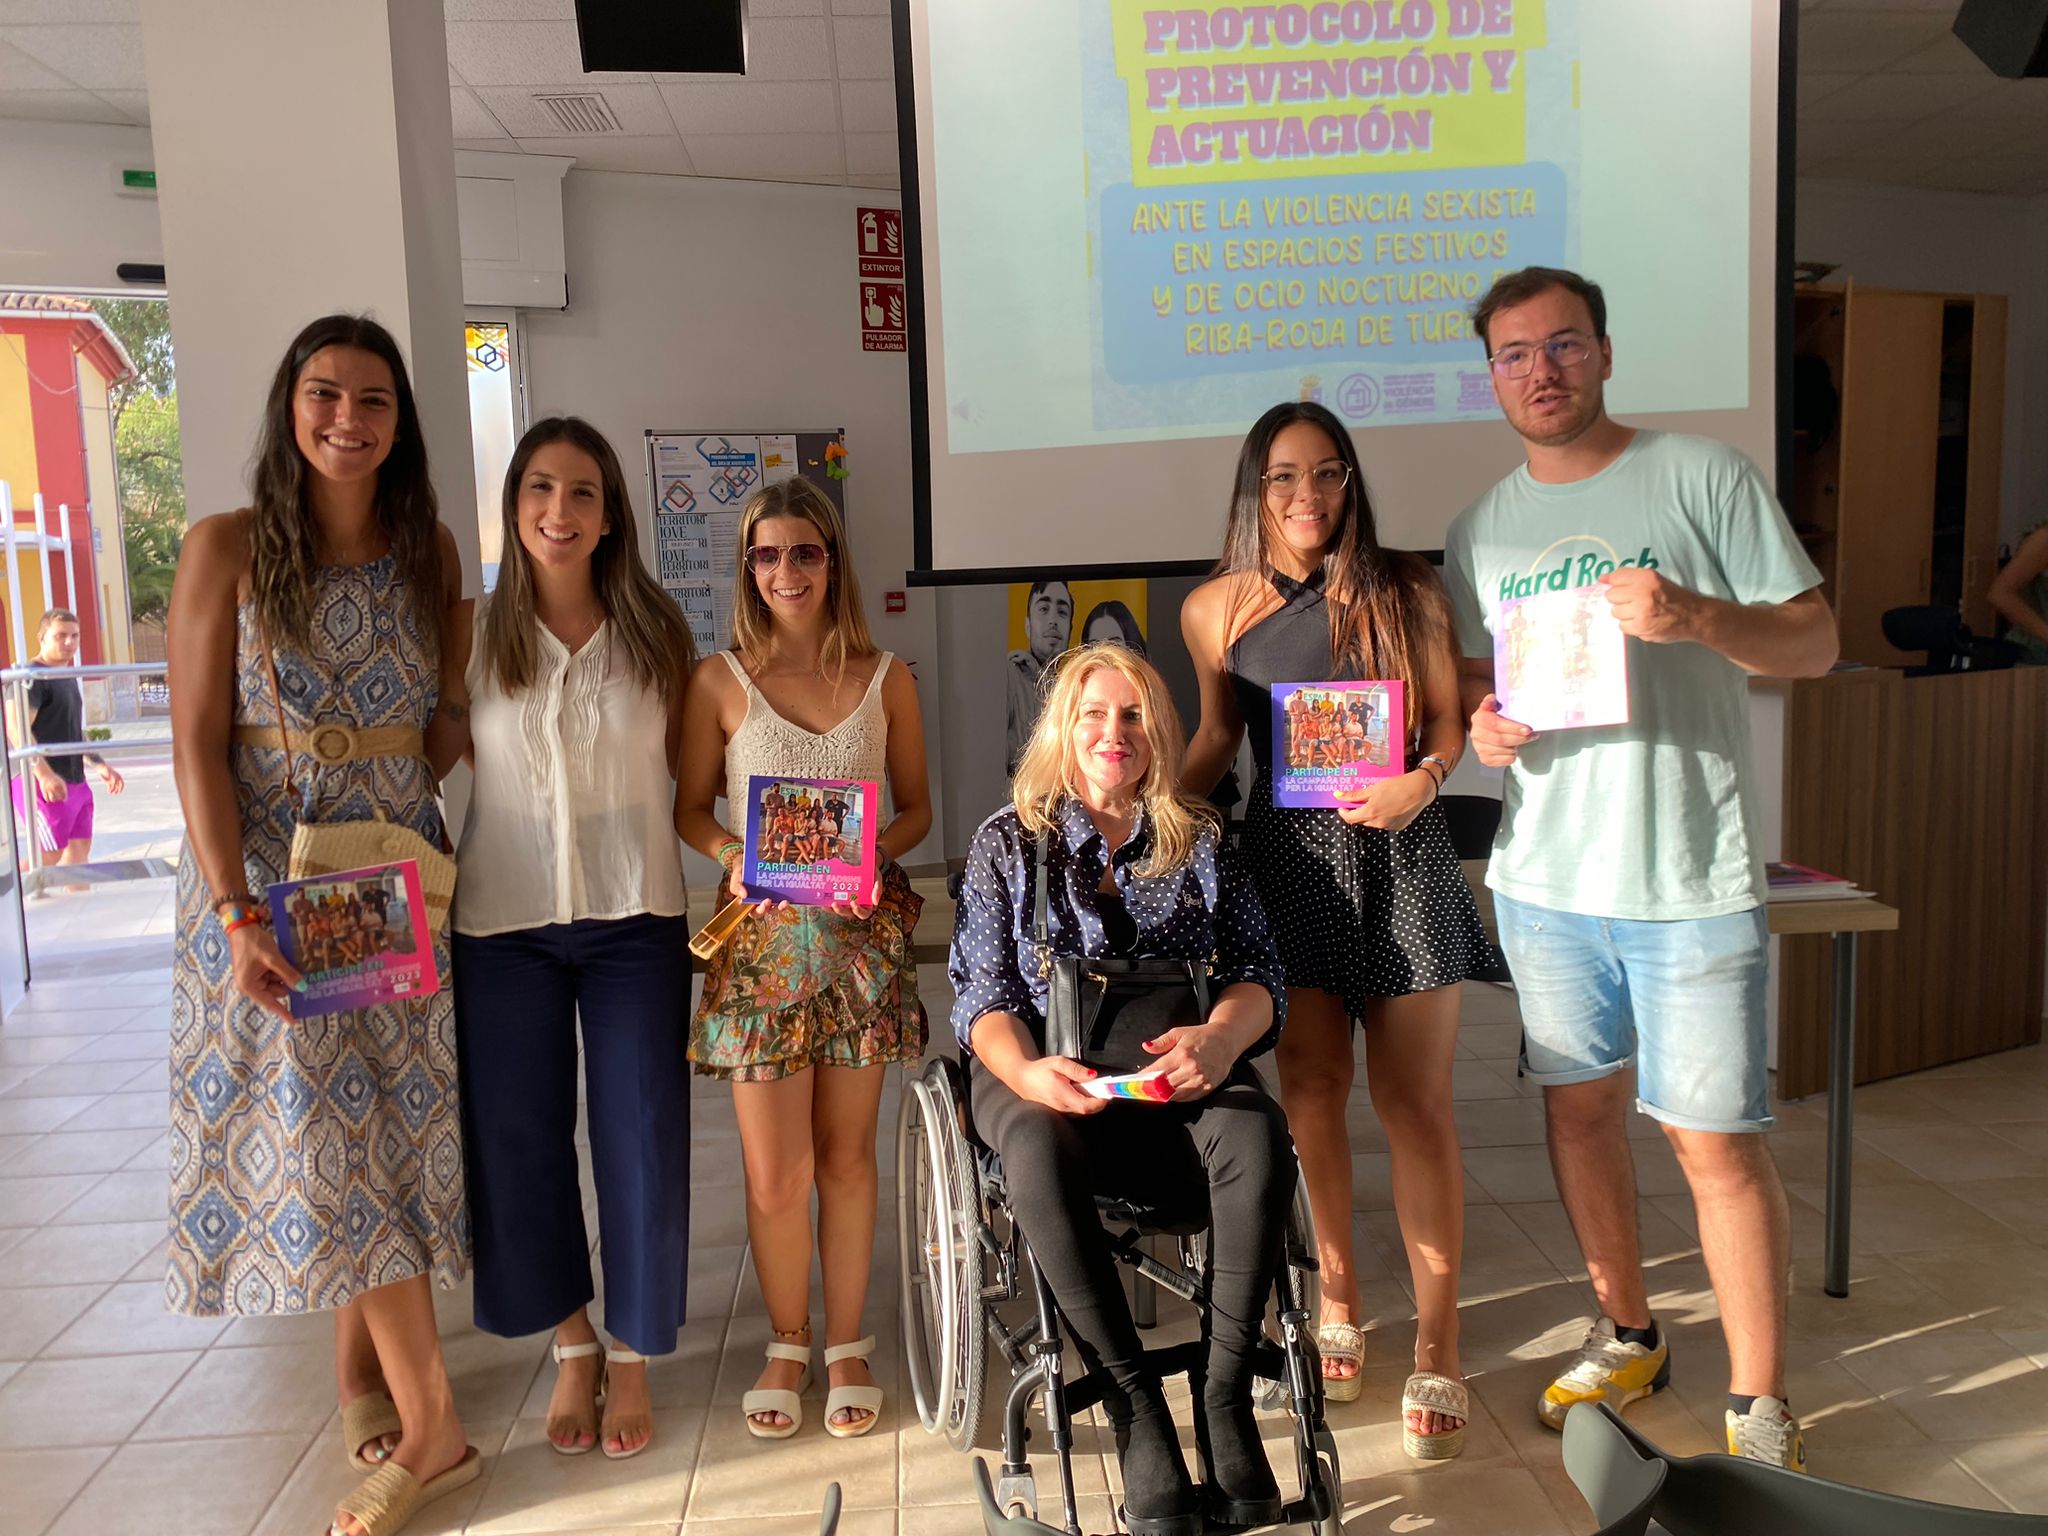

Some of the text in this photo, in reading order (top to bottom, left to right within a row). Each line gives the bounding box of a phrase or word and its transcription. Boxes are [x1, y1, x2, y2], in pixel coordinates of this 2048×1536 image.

[1142, 0, 1515, 52] PROTOCOLO DE
[1145, 46, 1518, 112] PREVENCIÓN Y
[1147, 105, 1434, 167] ACTUACIÓN
[1131, 187, 1537, 234] ANTE LA VIOLENCIA SEXISTA
[1173, 228, 1508, 274] EN ESPACIOS FESTIVOS
[862, 263, 900, 273] EXTINTOR
[1184, 282, 1222, 314] DE
[1234, 277, 1305, 310] OCIO
[1317, 270, 1480, 306] NOCTURNO
[865, 333, 902, 342] PULSADOR
[1185, 316, 1346, 356] RIBA-ROJA
[1358, 313, 1393, 346] DE
[865, 342, 903, 351] DE ALARMA
[659, 514, 706, 526] TERRITORI
[1499, 557, 1573, 602] Hard
[1285, 767, 1358, 777] PARTICIPE EN
[757, 862, 831, 874] PARTICIPE EN
[832, 882, 860, 891] 2023
[304, 961, 363, 983] ARTICIPE
[390, 970, 421, 983] 2023
